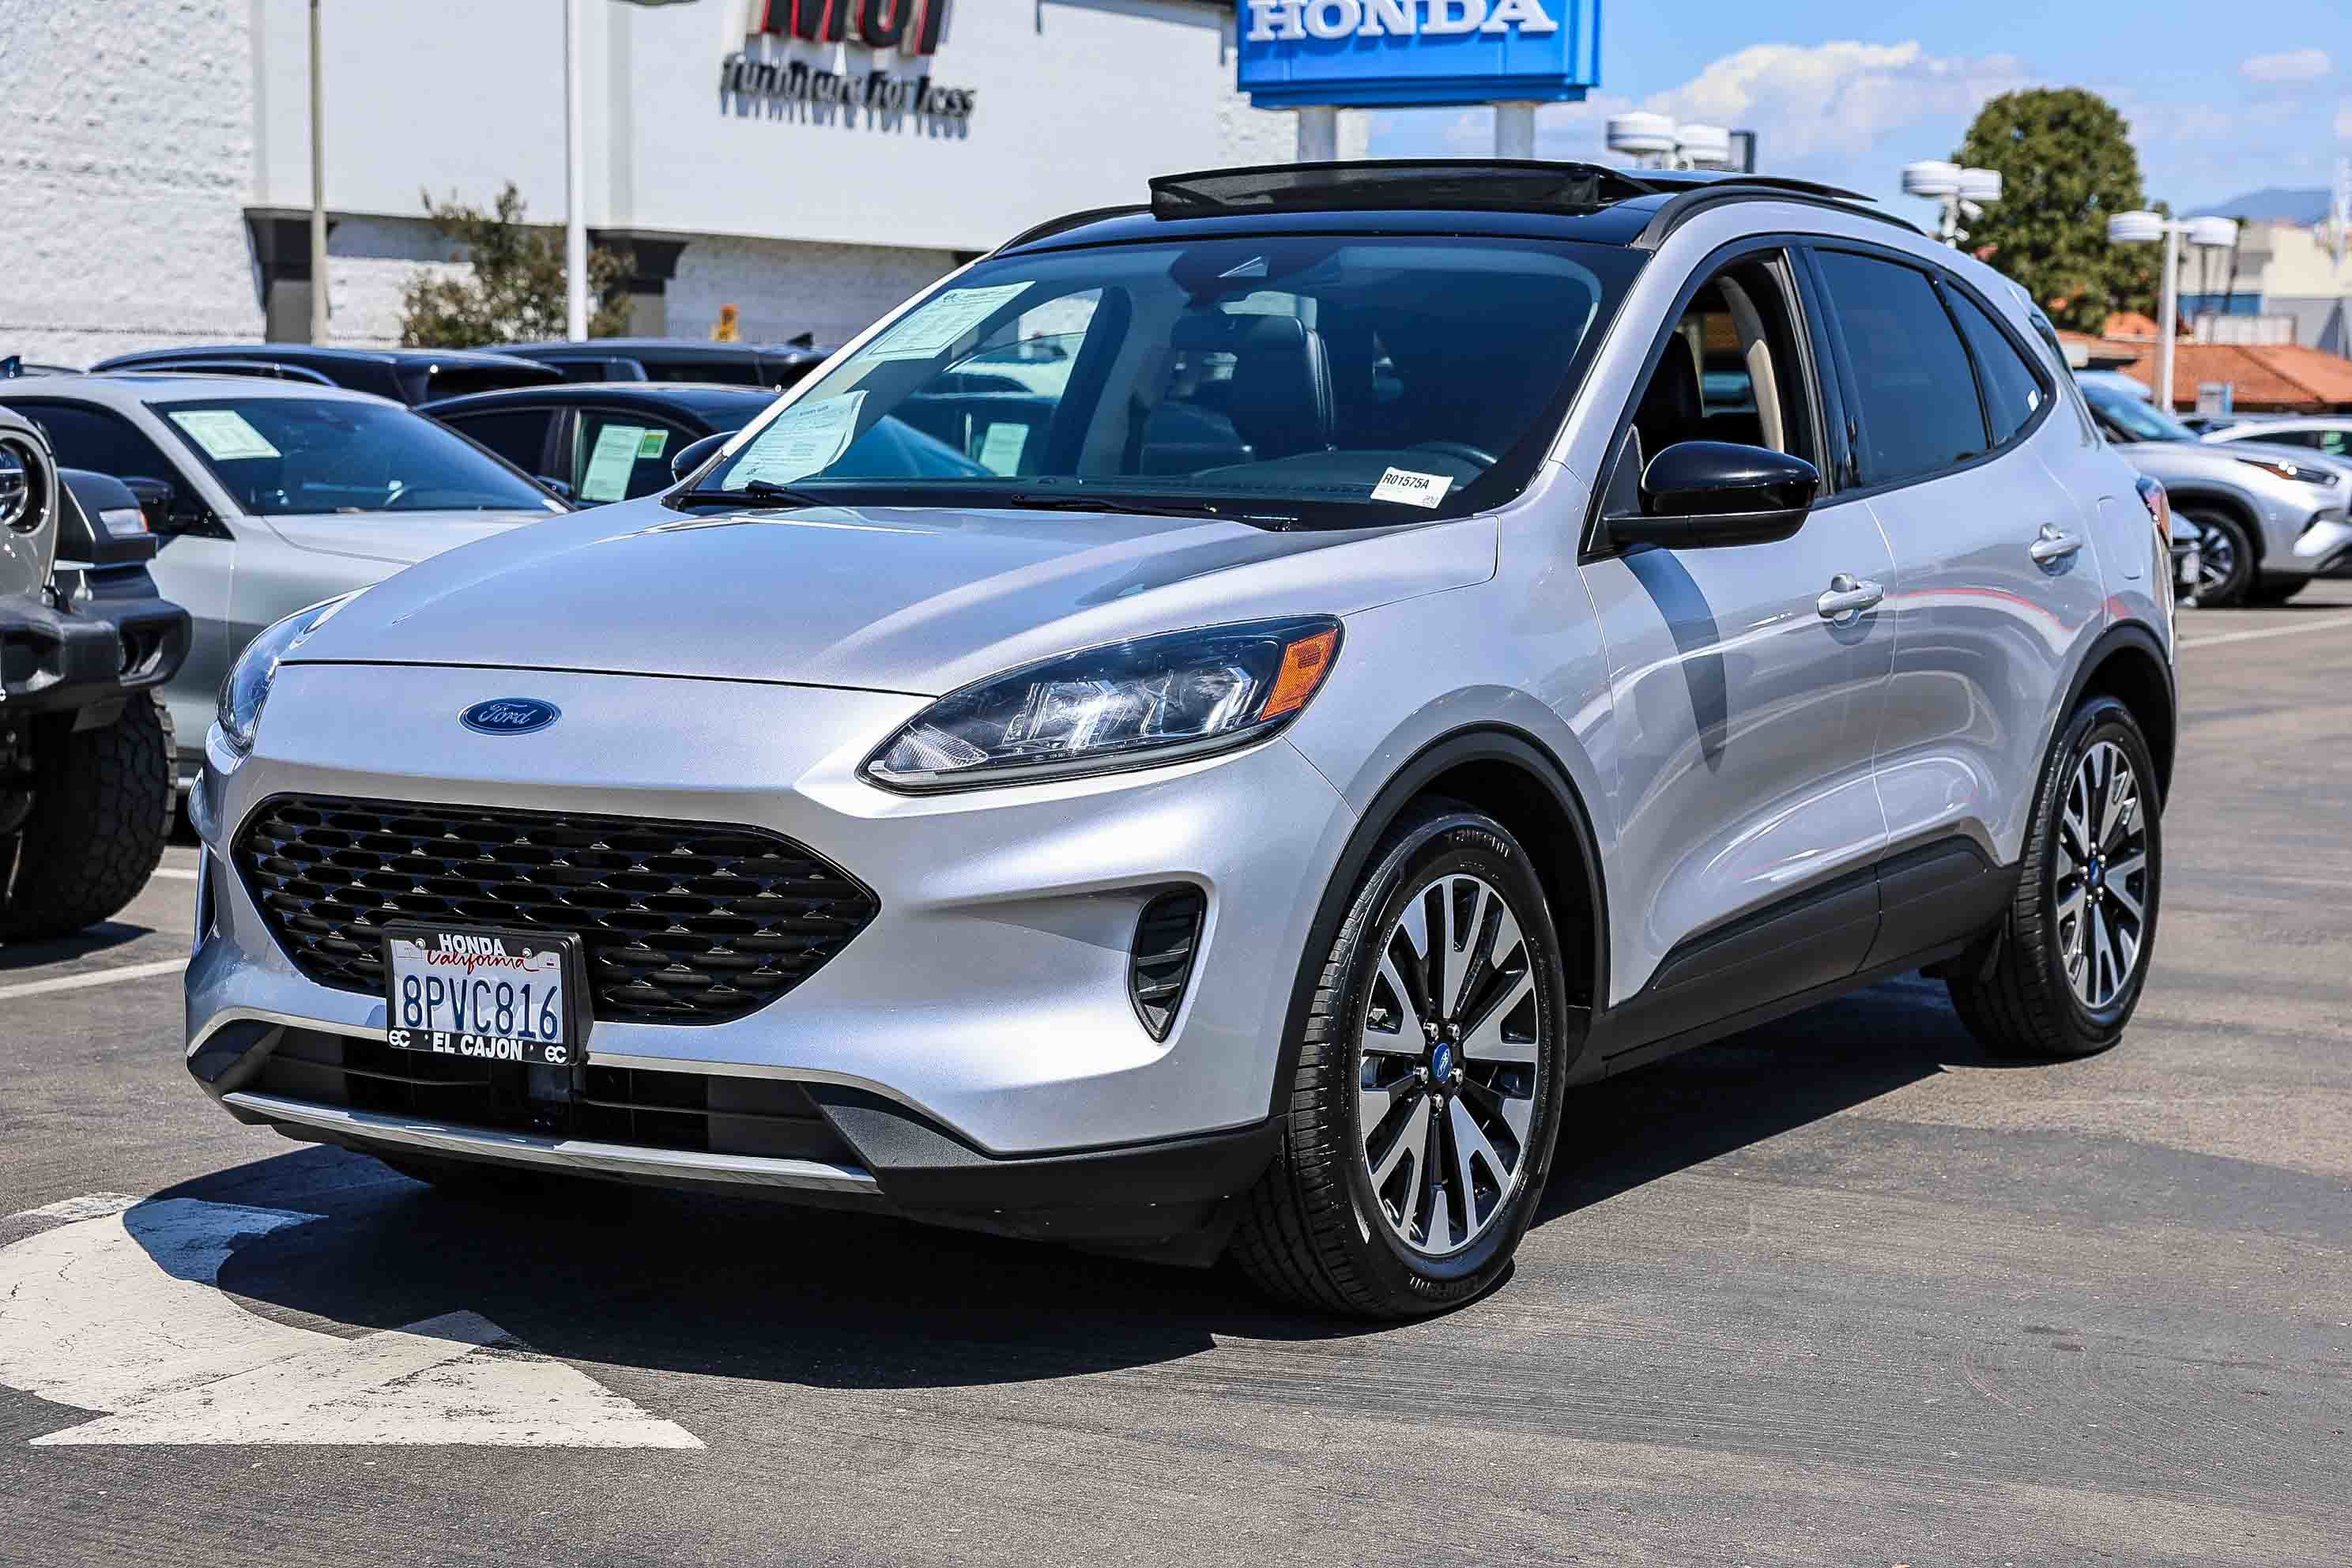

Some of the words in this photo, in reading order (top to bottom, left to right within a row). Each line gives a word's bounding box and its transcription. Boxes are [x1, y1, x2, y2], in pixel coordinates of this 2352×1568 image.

[1246, 0, 1559, 42] HONDA
[1382, 473, 1430, 489] R01575A
[478, 703, 537, 724] Ford
[439, 933, 507, 956] HONDA
[427, 949, 539, 975] California
[403, 974, 558, 1041] 8PVC816
[432, 1032, 455, 1054] EL
[460, 1036, 523, 1061] CAJON
